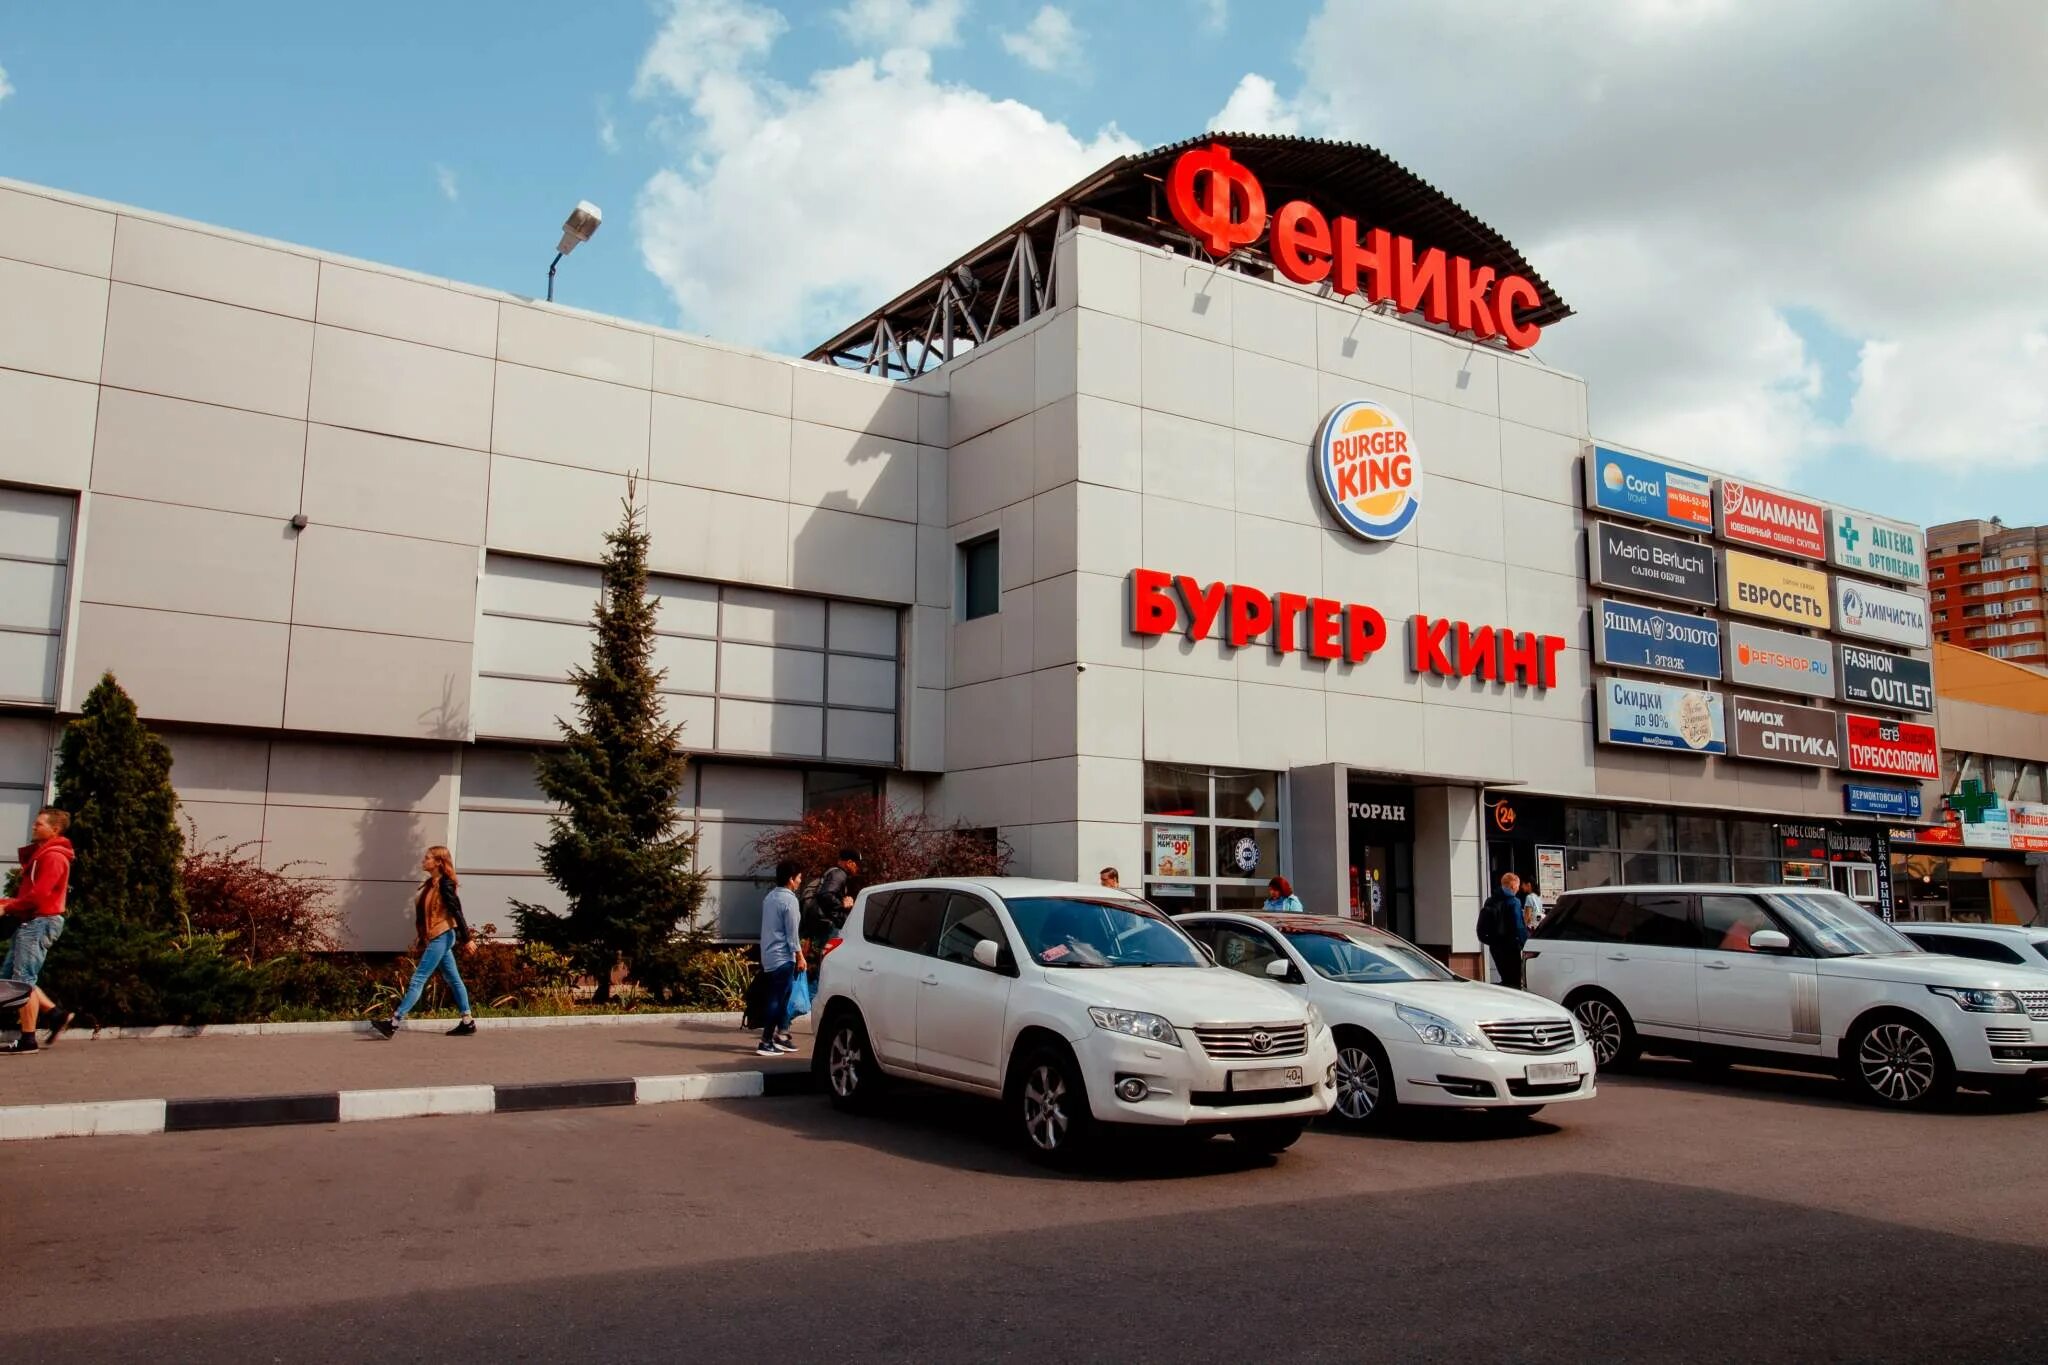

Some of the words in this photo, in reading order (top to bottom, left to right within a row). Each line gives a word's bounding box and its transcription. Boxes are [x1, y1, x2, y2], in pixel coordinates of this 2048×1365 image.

[1167, 143, 1542, 351] Феникс
[1332, 431, 1408, 466] BURGER
[1337, 455, 1412, 502] KING
[1626, 474, 1660, 497] Coral
[1627, 492, 1648, 505] travel
[1741, 495, 1819, 534] ДИАМАНД
[1773, 532, 1795, 545] ОБМЕН
[1797, 538, 1821, 551] СКУПКА
[1872, 526, 1914, 556] АПТЕКА
[1609, 537, 1649, 561] Mario
[1653, 547, 1704, 574] Berluchi
[1868, 552, 1920, 580] ОРТОПЕДИЯ
[1631, 565, 1659, 579] САЛОН
[1660, 569, 1685, 584] ОБУВИ
[1738, 581, 1822, 618] ЕВРОСЕТЬ
[1865, 601, 1924, 630] ХИМЧИСТКА
[1130, 568, 1387, 664] БУРГЕР
[1410, 614, 1566, 689] КИНГ
[1604, 611, 1652, 636] ЯШМА
[1665, 622, 1718, 647] ЗОЛОТО
[1644, 649, 1651, 665] 1
[1654, 655, 1685, 670] этаж
[1752, 650, 1827, 675] PETSHOP.RU
[1844, 649, 1893, 674] FASHION
[1848, 685, 1853, 696] 2
[1871, 676, 1931, 708] OUTLET
[1635, 714, 1646, 728] до
[1648, 713, 1669, 729] 90%
[1738, 708, 1784, 727] ИМИДЖ
[1762, 730, 1838, 758] ОПТИКА
[1851, 744, 1936, 774] ТУРБОСОЛЯРИЙ
[1348, 802, 1406, 821] ТОРАН
[1852, 790, 1903, 804] ЛЕРМОНТОВСКИЙ
[1910, 795, 1919, 808] 19
[1500, 807, 1514, 823] 24
[1780, 823, 1799, 837] КОФЕ
[1799, 826, 1804, 838] С
[1174, 840, 1188, 856] 99
[1285, 1069, 1298, 1081] 40
[1563, 1062, 1576, 1073] 777
